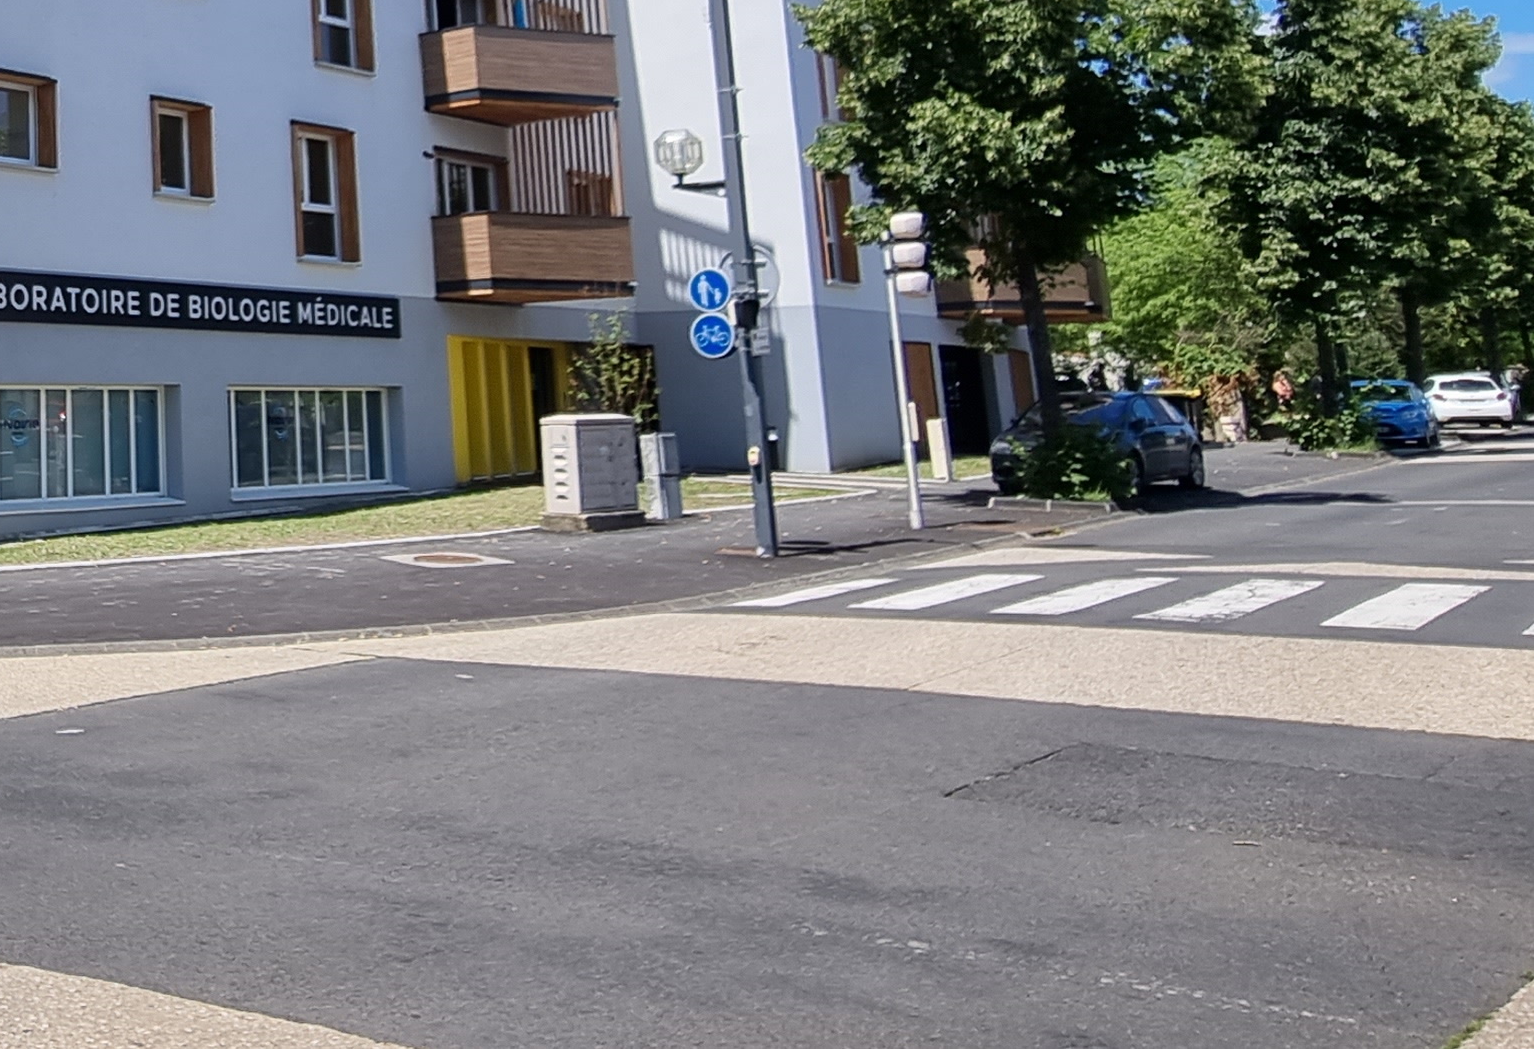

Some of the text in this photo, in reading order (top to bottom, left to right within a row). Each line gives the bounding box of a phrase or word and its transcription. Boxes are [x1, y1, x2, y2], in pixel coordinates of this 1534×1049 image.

[149, 292, 180, 318] DE
[188, 295, 291, 324] BIOLOGIE
[298, 297, 394, 329] MÉDICALE
